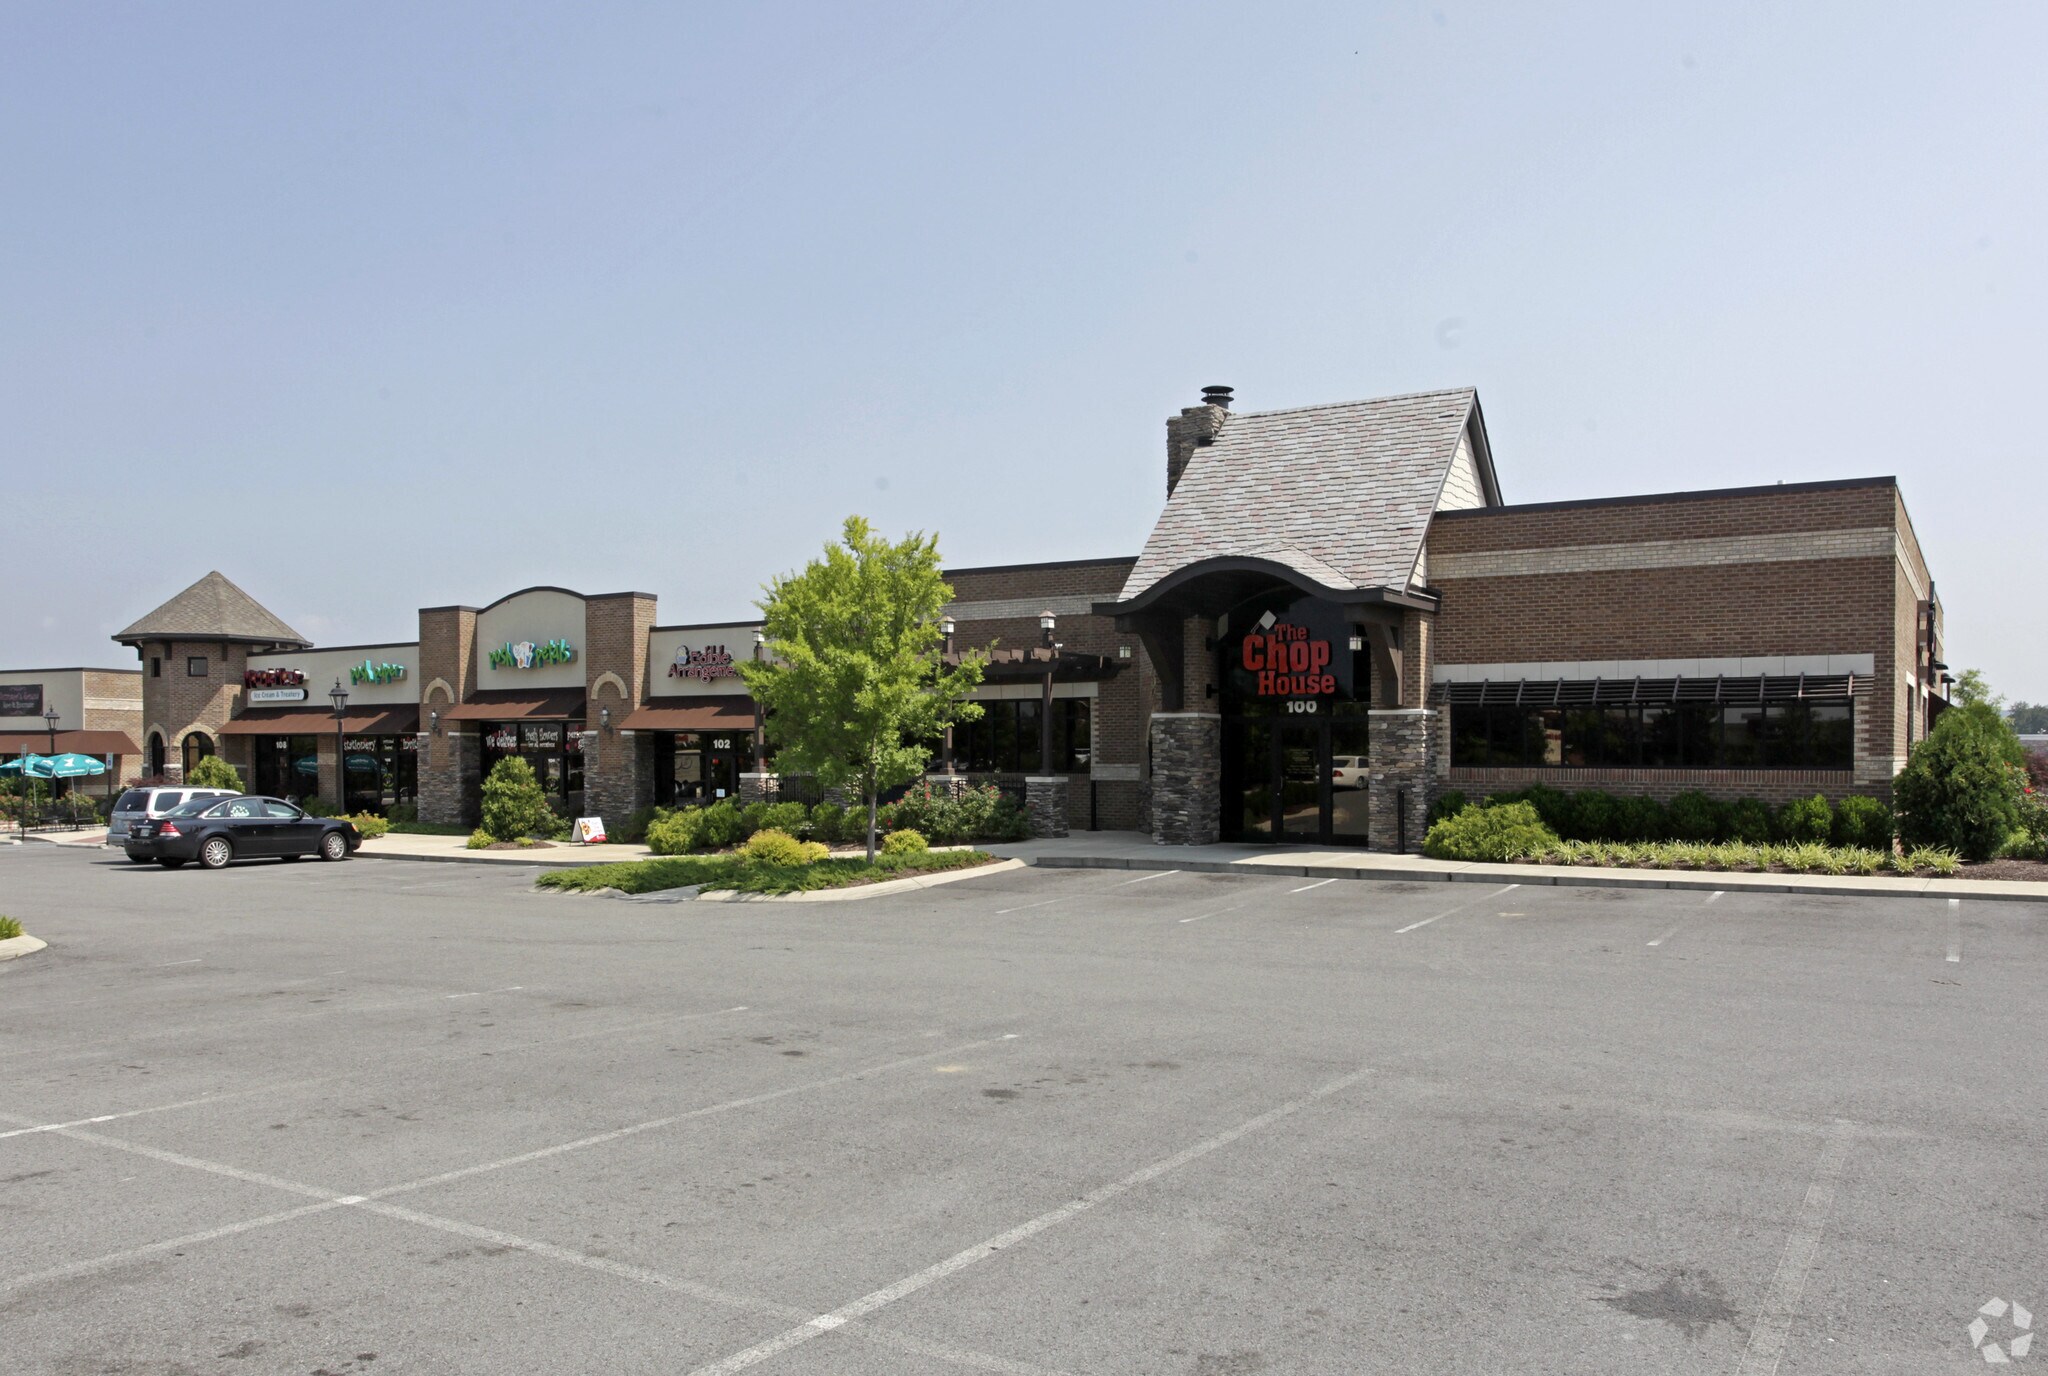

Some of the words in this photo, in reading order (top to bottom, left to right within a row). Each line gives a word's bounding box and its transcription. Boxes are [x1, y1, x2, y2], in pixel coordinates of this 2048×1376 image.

[1274, 624, 1308, 641] The
[489, 642, 515, 670] posh
[536, 639, 571, 668] petals
[690, 645, 733, 665] Edible
[1243, 633, 1330, 675] Chop
[668, 663, 738, 684] Arrangeme
[1258, 670, 1336, 696] House
[1286, 700, 1317, 713] 100
[344, 739, 376, 751] stationery
[713, 739, 731, 749] 102
